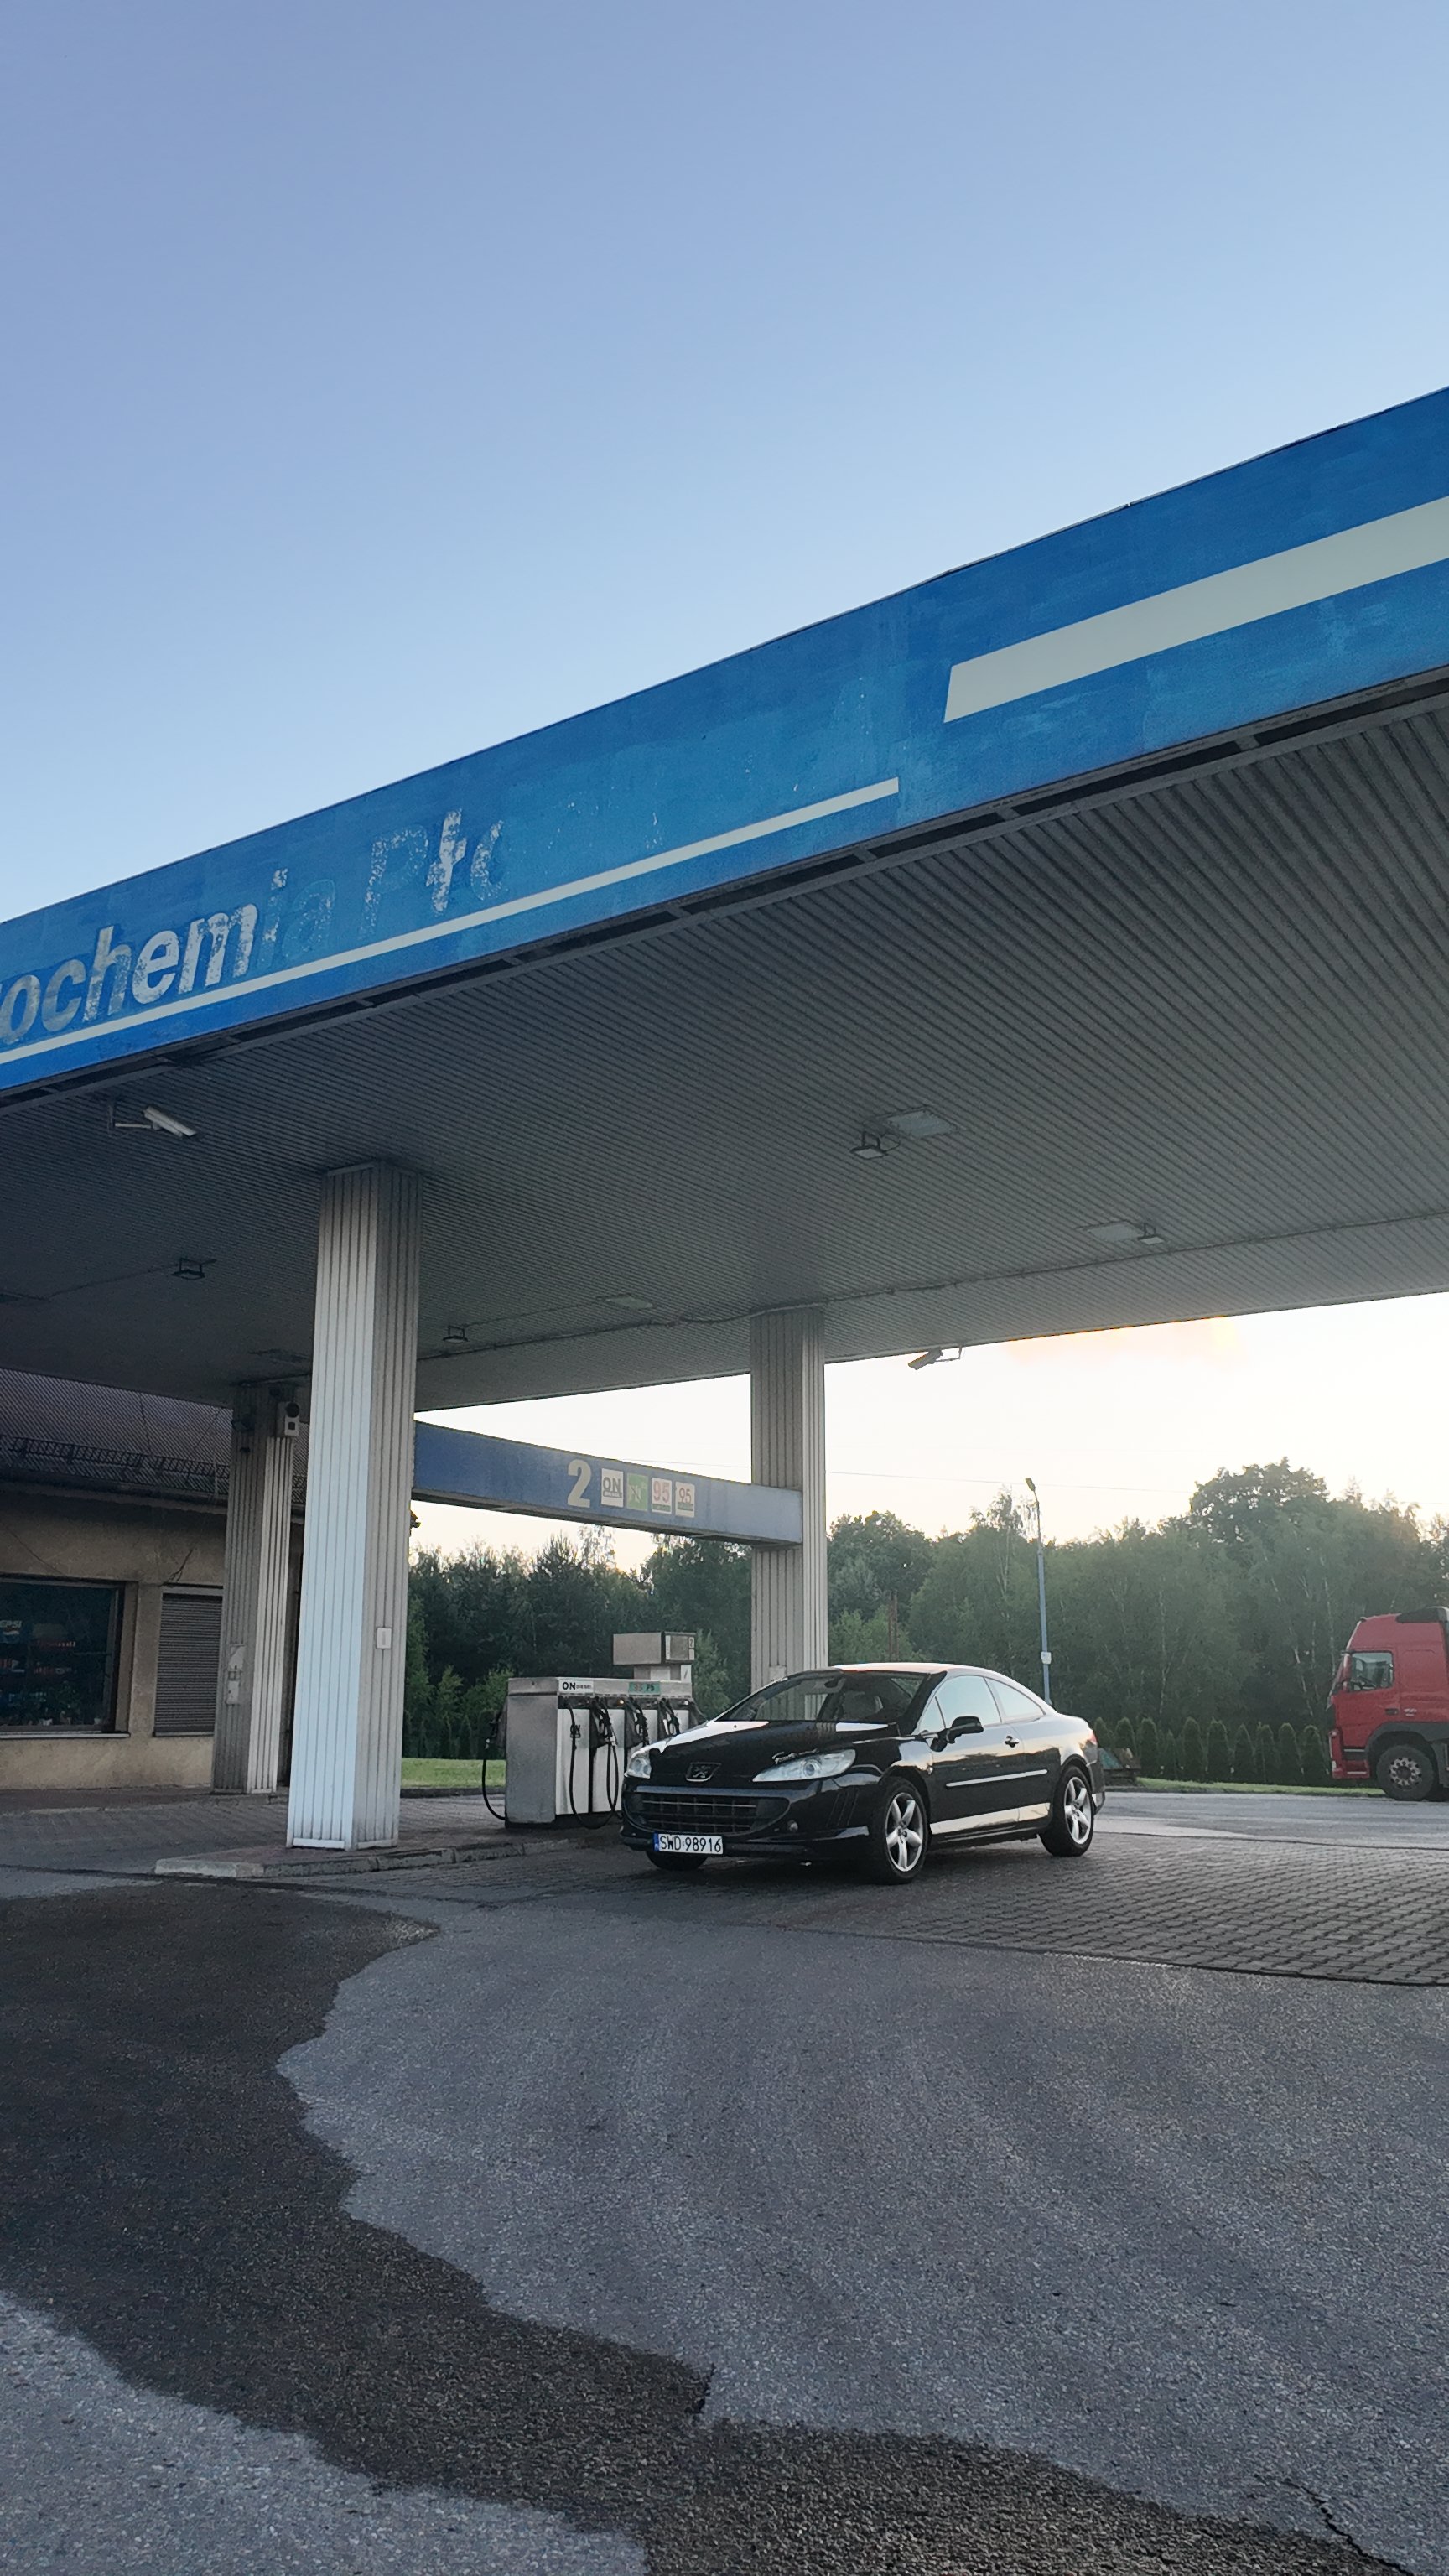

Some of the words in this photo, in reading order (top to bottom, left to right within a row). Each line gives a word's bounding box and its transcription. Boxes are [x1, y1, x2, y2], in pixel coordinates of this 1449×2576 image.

[0, 867, 335, 1046] ochemia
[567, 1459, 592, 1509] 2
[602, 1477, 621, 1493] ON
[652, 1480, 670, 1504] 95
[678, 1487, 692, 1504] 95
[562, 1682, 576, 1690] ON
[660, 1835, 682, 1851] SWD
[685, 1836, 721, 1852] 98916
